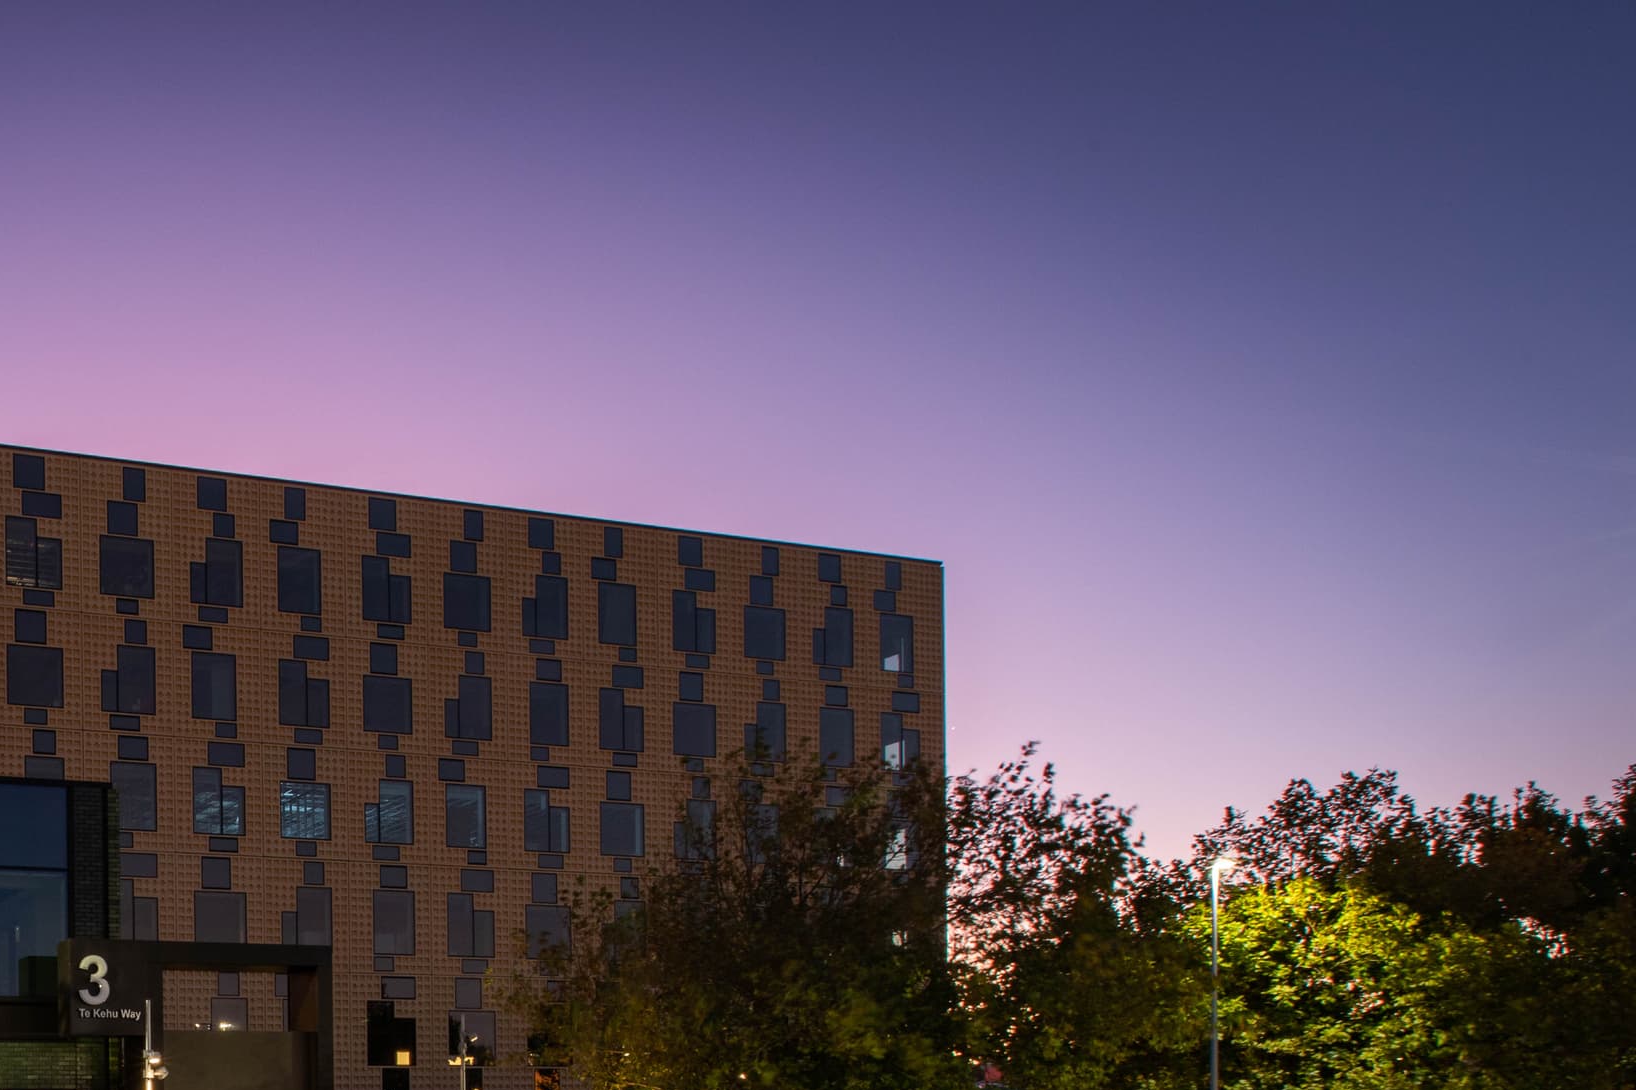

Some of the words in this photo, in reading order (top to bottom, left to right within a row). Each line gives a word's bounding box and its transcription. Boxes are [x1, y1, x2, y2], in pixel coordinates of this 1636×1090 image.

[78, 954, 110, 1006] 3
[79, 1008, 91, 1018] Te
[93, 1008, 118, 1019] Kehu
[121, 1008, 141, 1021] Way
